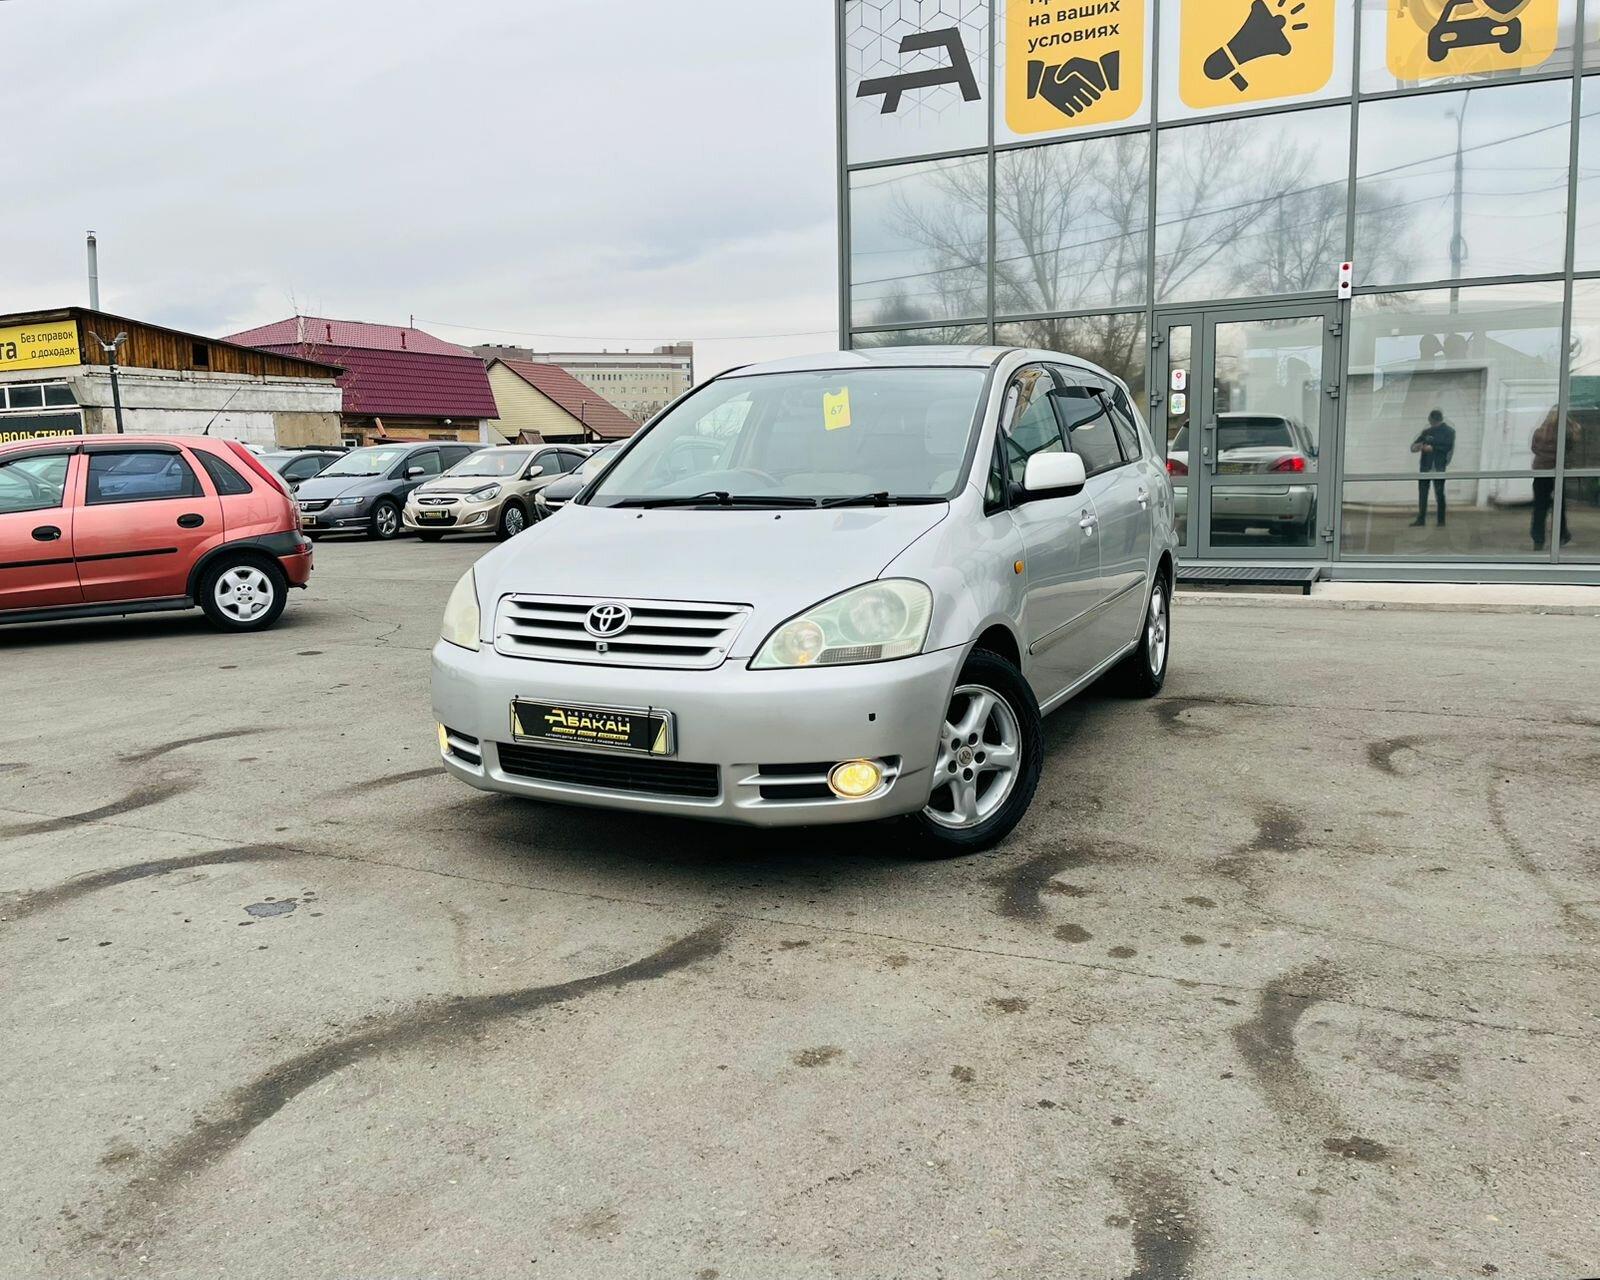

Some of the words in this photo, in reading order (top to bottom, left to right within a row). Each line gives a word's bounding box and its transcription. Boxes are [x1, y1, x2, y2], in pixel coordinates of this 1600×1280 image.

[1028, 13, 1050, 27] на
[1057, 0, 1120, 22] ваших
[1027, 23, 1120, 53] условиях
[20, 332, 36, 343] Без
[37, 331, 74, 344] справок
[31, 349, 37, 358] о
[38, 347, 76, 359] доходах
[831, 404, 843, 415] 67
[0, 429, 74, 443] ВОЛЬСТВИЯ
[545, 709, 631, 733] АБАКАН
[567, 711, 630, 722] АВТОСАЛОН
